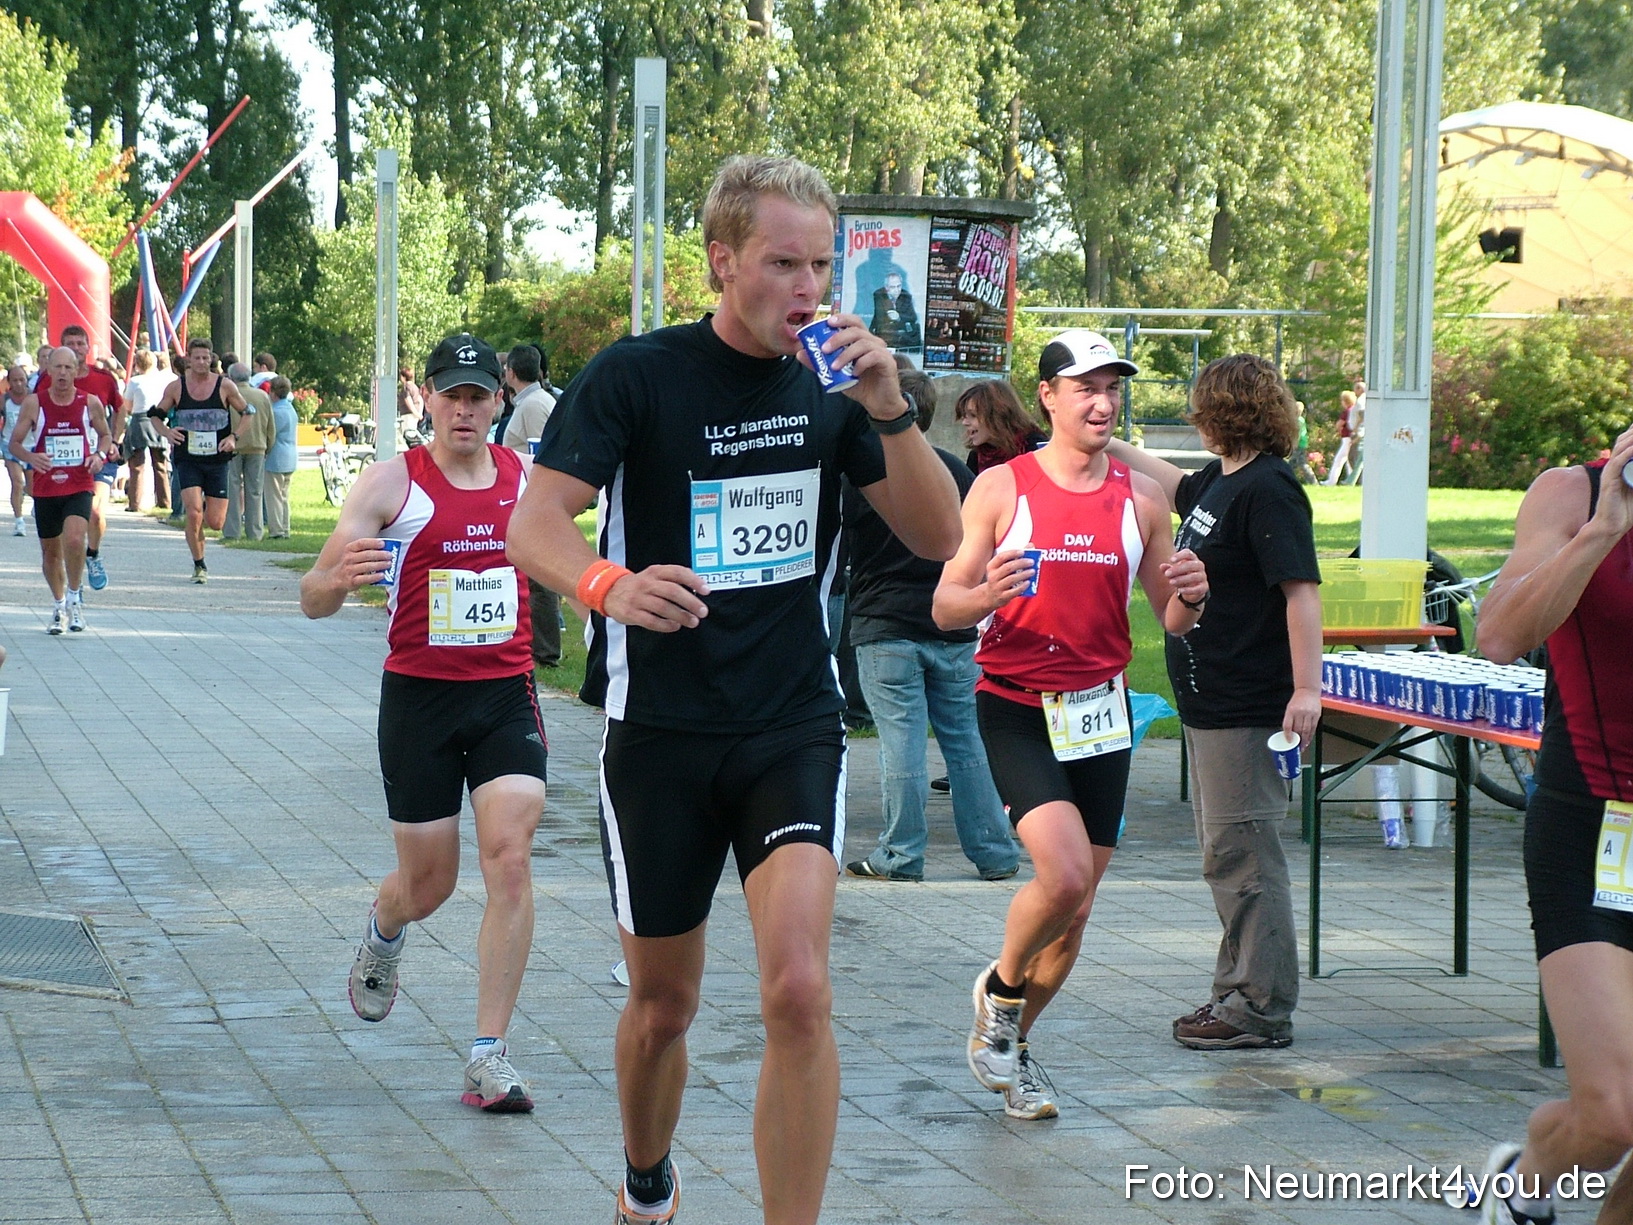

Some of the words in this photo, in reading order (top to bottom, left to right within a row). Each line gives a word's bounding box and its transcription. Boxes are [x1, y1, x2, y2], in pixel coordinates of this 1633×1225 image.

[855, 220, 882, 231] Bruno
[848, 228, 902, 257] Jonas
[965, 245, 1009, 290] ROCK
[959, 271, 1005, 309] 08.09.07
[705, 425, 736, 439] LLC
[739, 415, 809, 434] Marathon
[199, 441, 212, 449] 445
[711, 432, 804, 456] Regensburg
[57, 449, 80, 458] 2911
[729, 486, 804, 510] Wolfgang
[466, 524, 495, 536] DAV
[697, 523, 706, 539] A
[732, 519, 809, 557] 3290
[443, 538, 506, 553] Röthenba
[1064, 533, 1095, 547] DAV
[1040, 548, 1119, 566] Röthenbach
[775, 559, 814, 576] PFLEIDERER
[455, 577, 502, 591] Matthias
[433, 598, 440, 610] A
[465, 601, 506, 624] 454
[1067, 685, 1113, 705] Alexand
[1081, 707, 1114, 735] 811
[1604, 840, 1612, 855] A
[1597, 890, 1633, 905] BOC
